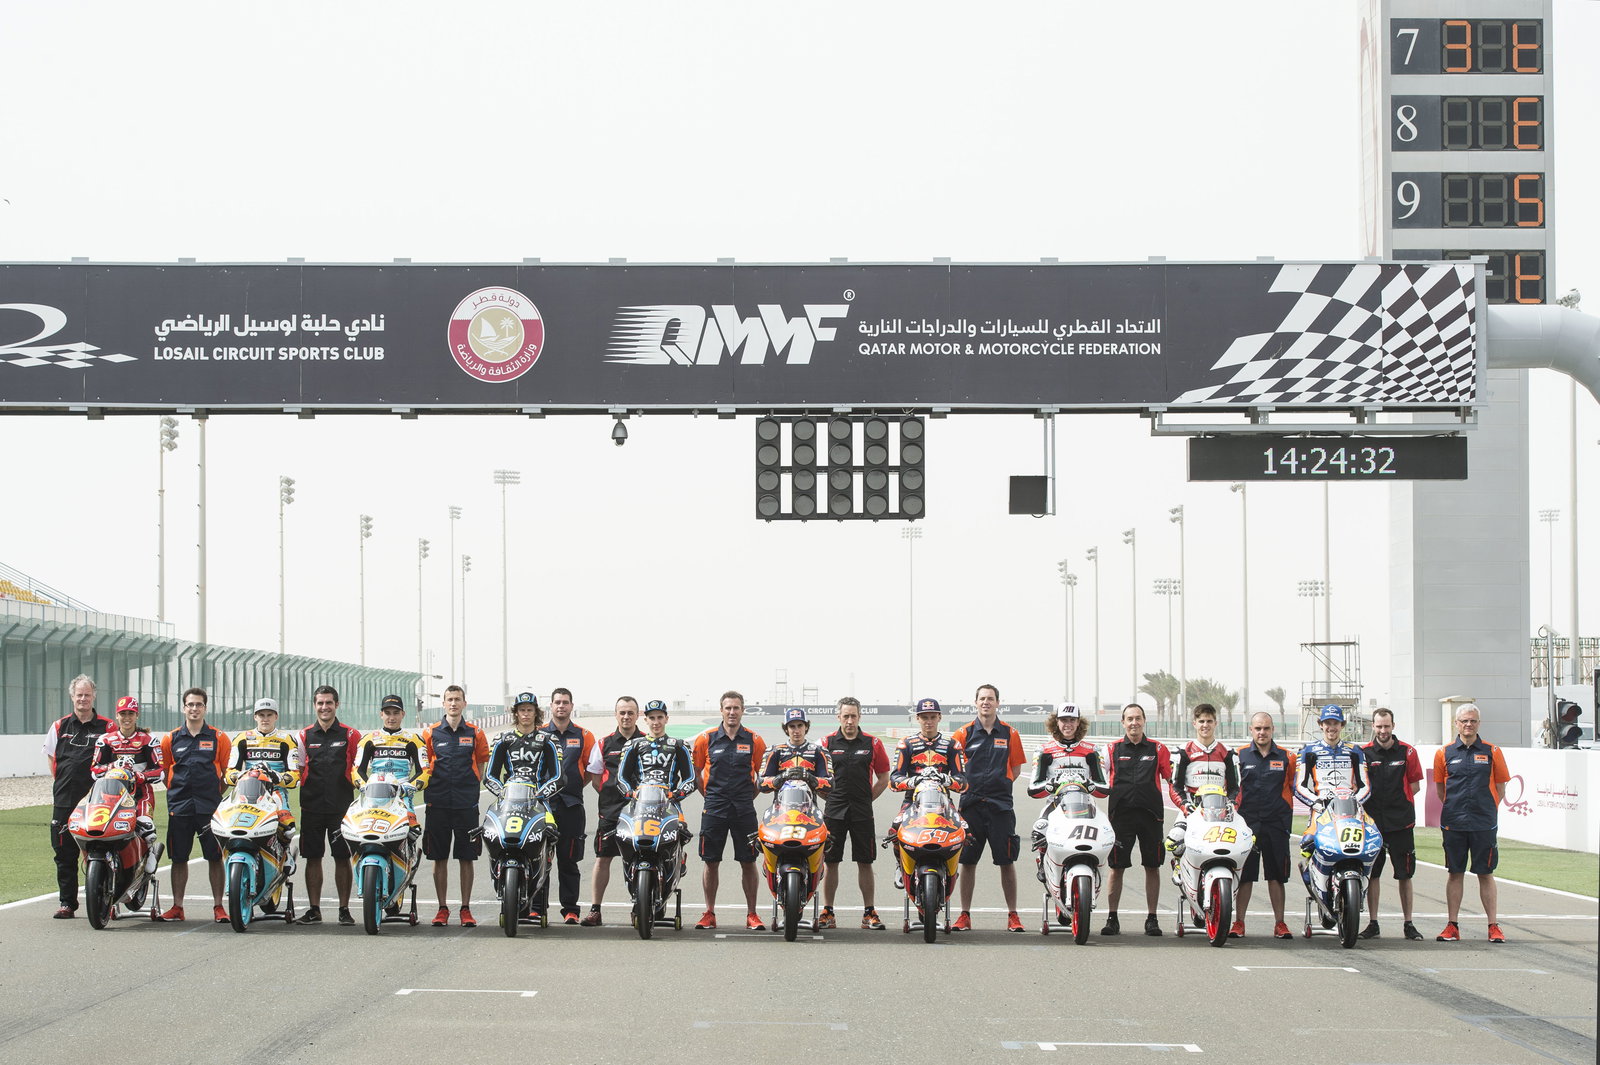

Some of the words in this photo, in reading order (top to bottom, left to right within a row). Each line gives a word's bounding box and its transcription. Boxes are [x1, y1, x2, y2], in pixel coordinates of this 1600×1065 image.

[1396, 28, 1419, 65] 7
[1396, 104, 1418, 142] 8
[1513, 97, 1541, 150] E
[1396, 180, 1421, 220] 9
[472, 293, 497, 310] قطر
[154, 314, 230, 341] الرياضي
[233, 314, 297, 337] لوسيل
[301, 314, 341, 336] حلبة
[344, 314, 385, 341] نادي
[858, 319, 901, 336] النارية
[905, 319, 976, 337] والدراجات
[981, 319, 1049, 337] للسيارات
[1053, 319, 1111, 341] القطري
[1115, 319, 1161, 334] الاتحاد
[602, 303, 850, 366] QMMF
[154, 346, 209, 361] LOSAIL
[213, 346, 275, 361] CIRCUIT
[278, 346, 340, 361] SPORTS
[343, 346, 385, 361] CLUB
[520, 343, 538, 364] وزارة
[858, 342, 906, 356] QATAR
[910, 342, 961, 356] MOTOR
[965, 343, 975, 356] &
[979, 342, 1075, 356] MOTORCYCLE
[1079, 342, 1161, 356] FEDERATION
[457, 343, 487, 376] والرياضة
[488, 361, 522, 376] الثقافة
[1264, 447, 1396, 475] 14:24:32
[251, 751, 261, 759] LG
[379, 749, 388, 757] LG
[511, 749, 540, 767] sky
[505, 817, 524, 833] 8
[633, 820, 662, 837] 16
[779, 826, 808, 840] 23
[483, 831, 497, 843] sky
[528, 831, 543, 843] sky
[662, 830, 677, 842] sky
[917, 829, 949, 844] 64
[1203, 826, 1238, 843] 42
[1340, 827, 1363, 843] 65
